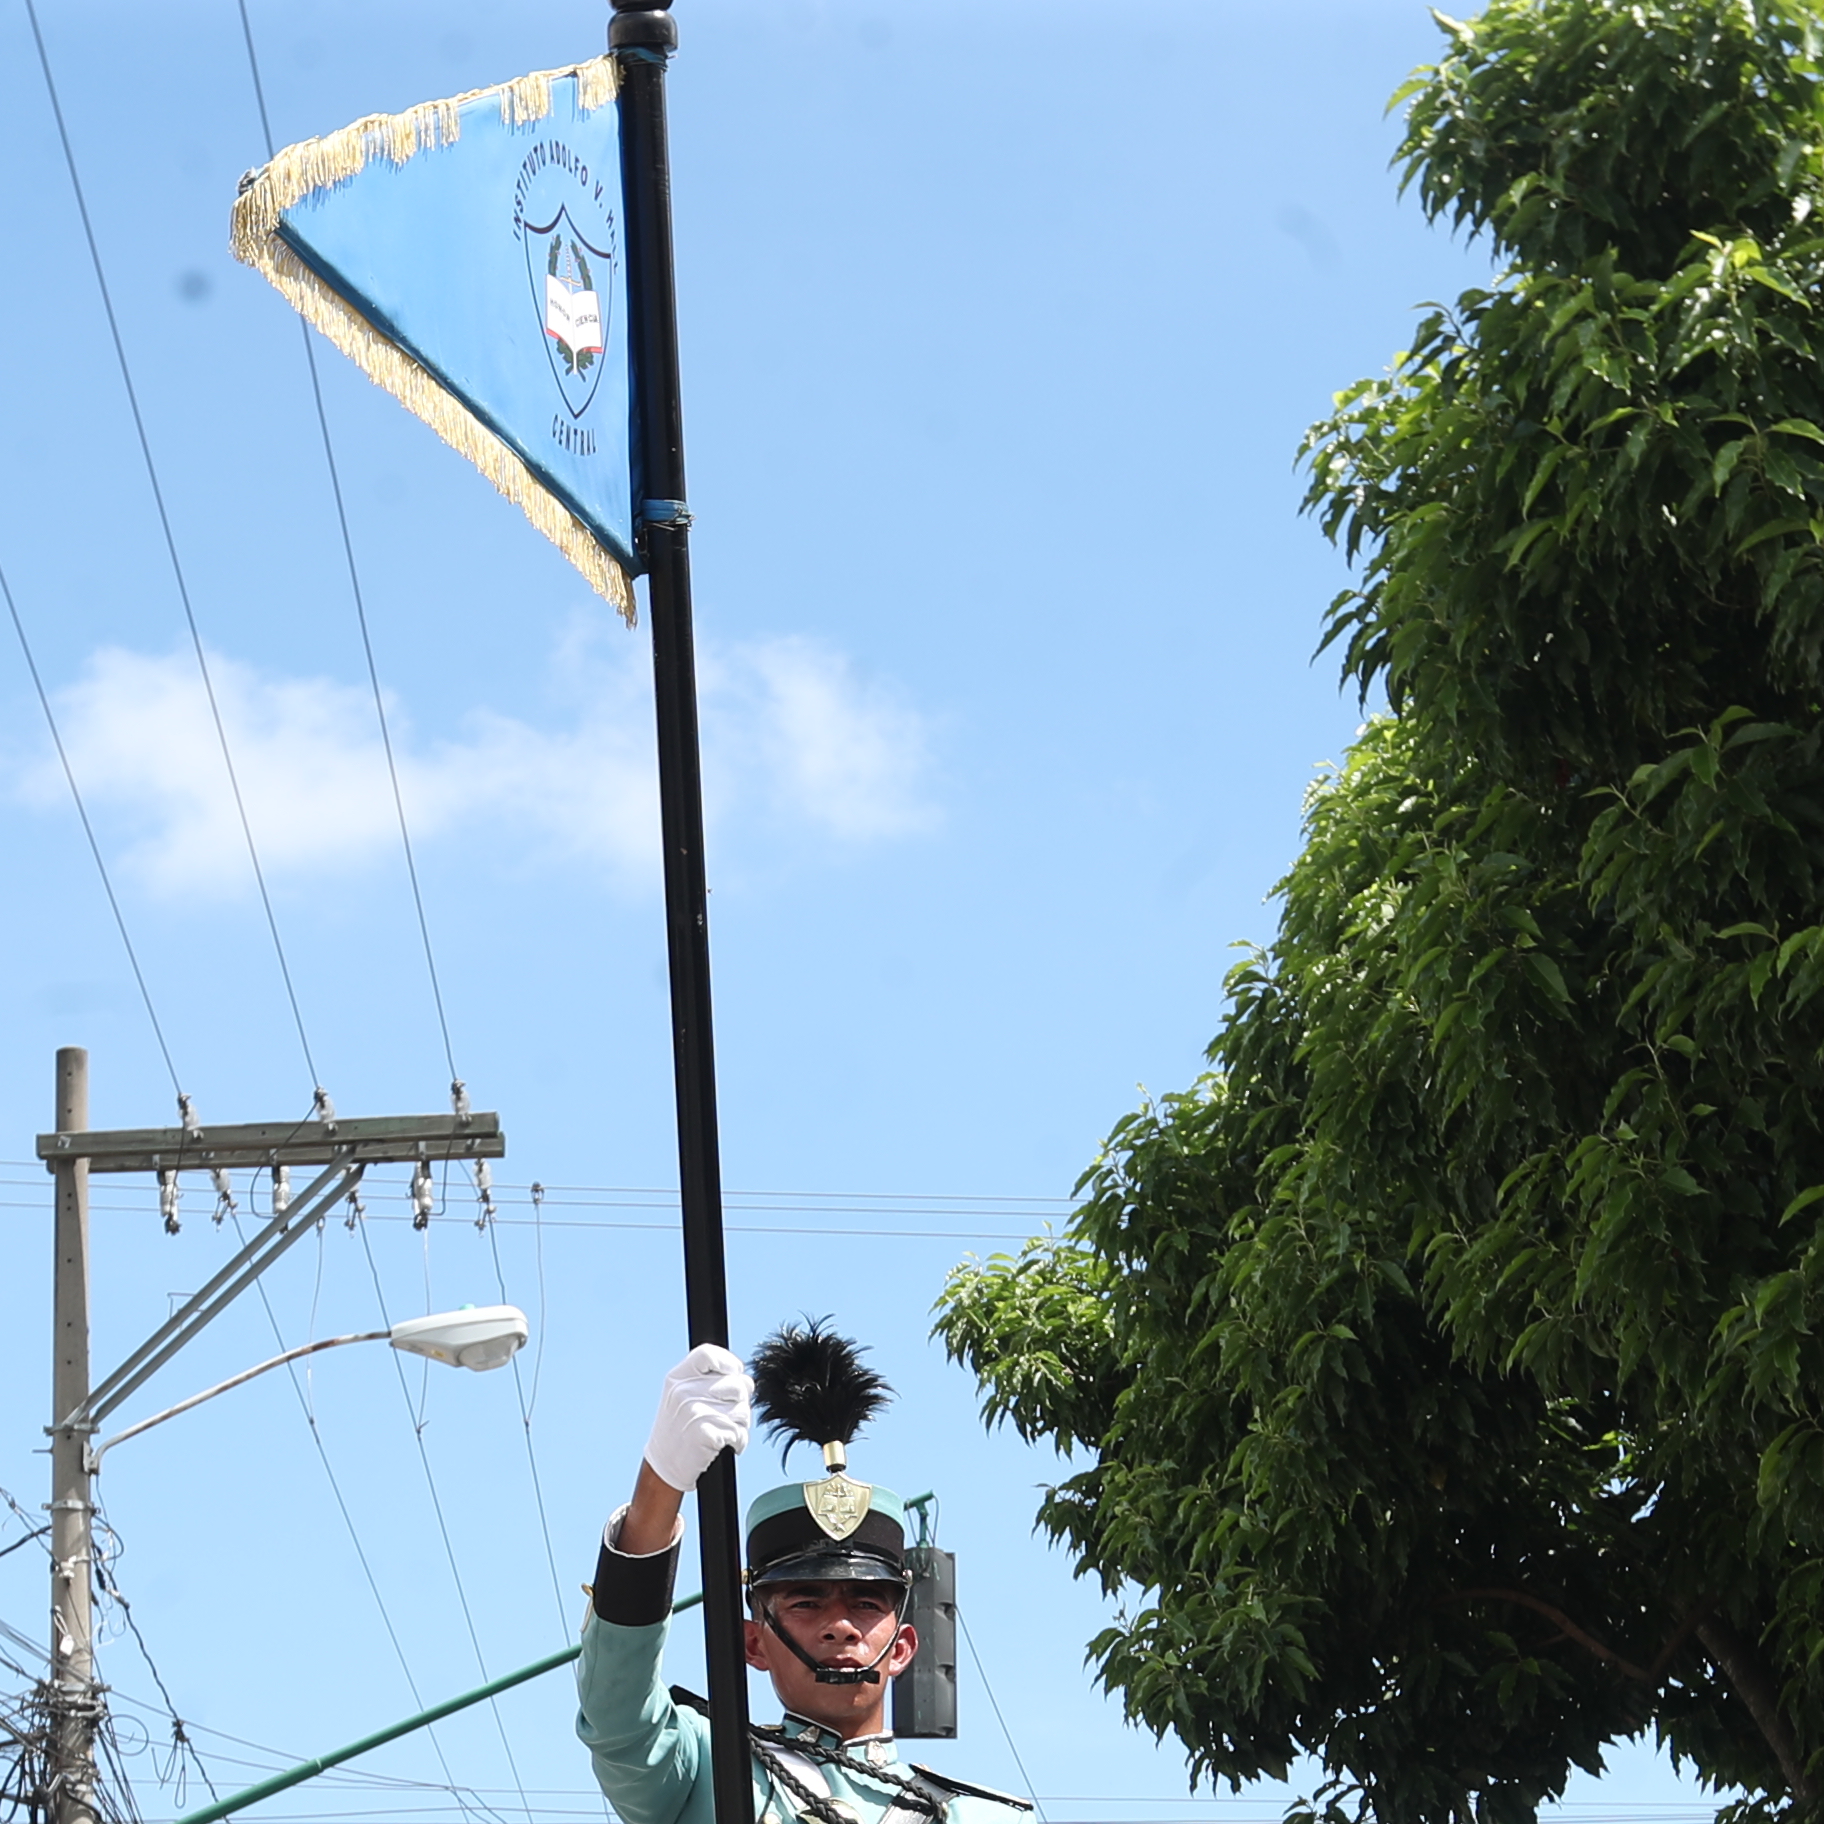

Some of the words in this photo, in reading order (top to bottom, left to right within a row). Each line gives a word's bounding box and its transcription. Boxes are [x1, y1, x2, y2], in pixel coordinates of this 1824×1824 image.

[513, 140, 546, 242] INSTITUTO
[549, 139, 588, 187] ADOLFO
[594, 179, 604, 209] V.
[552, 413, 596, 456] CENTRAL
